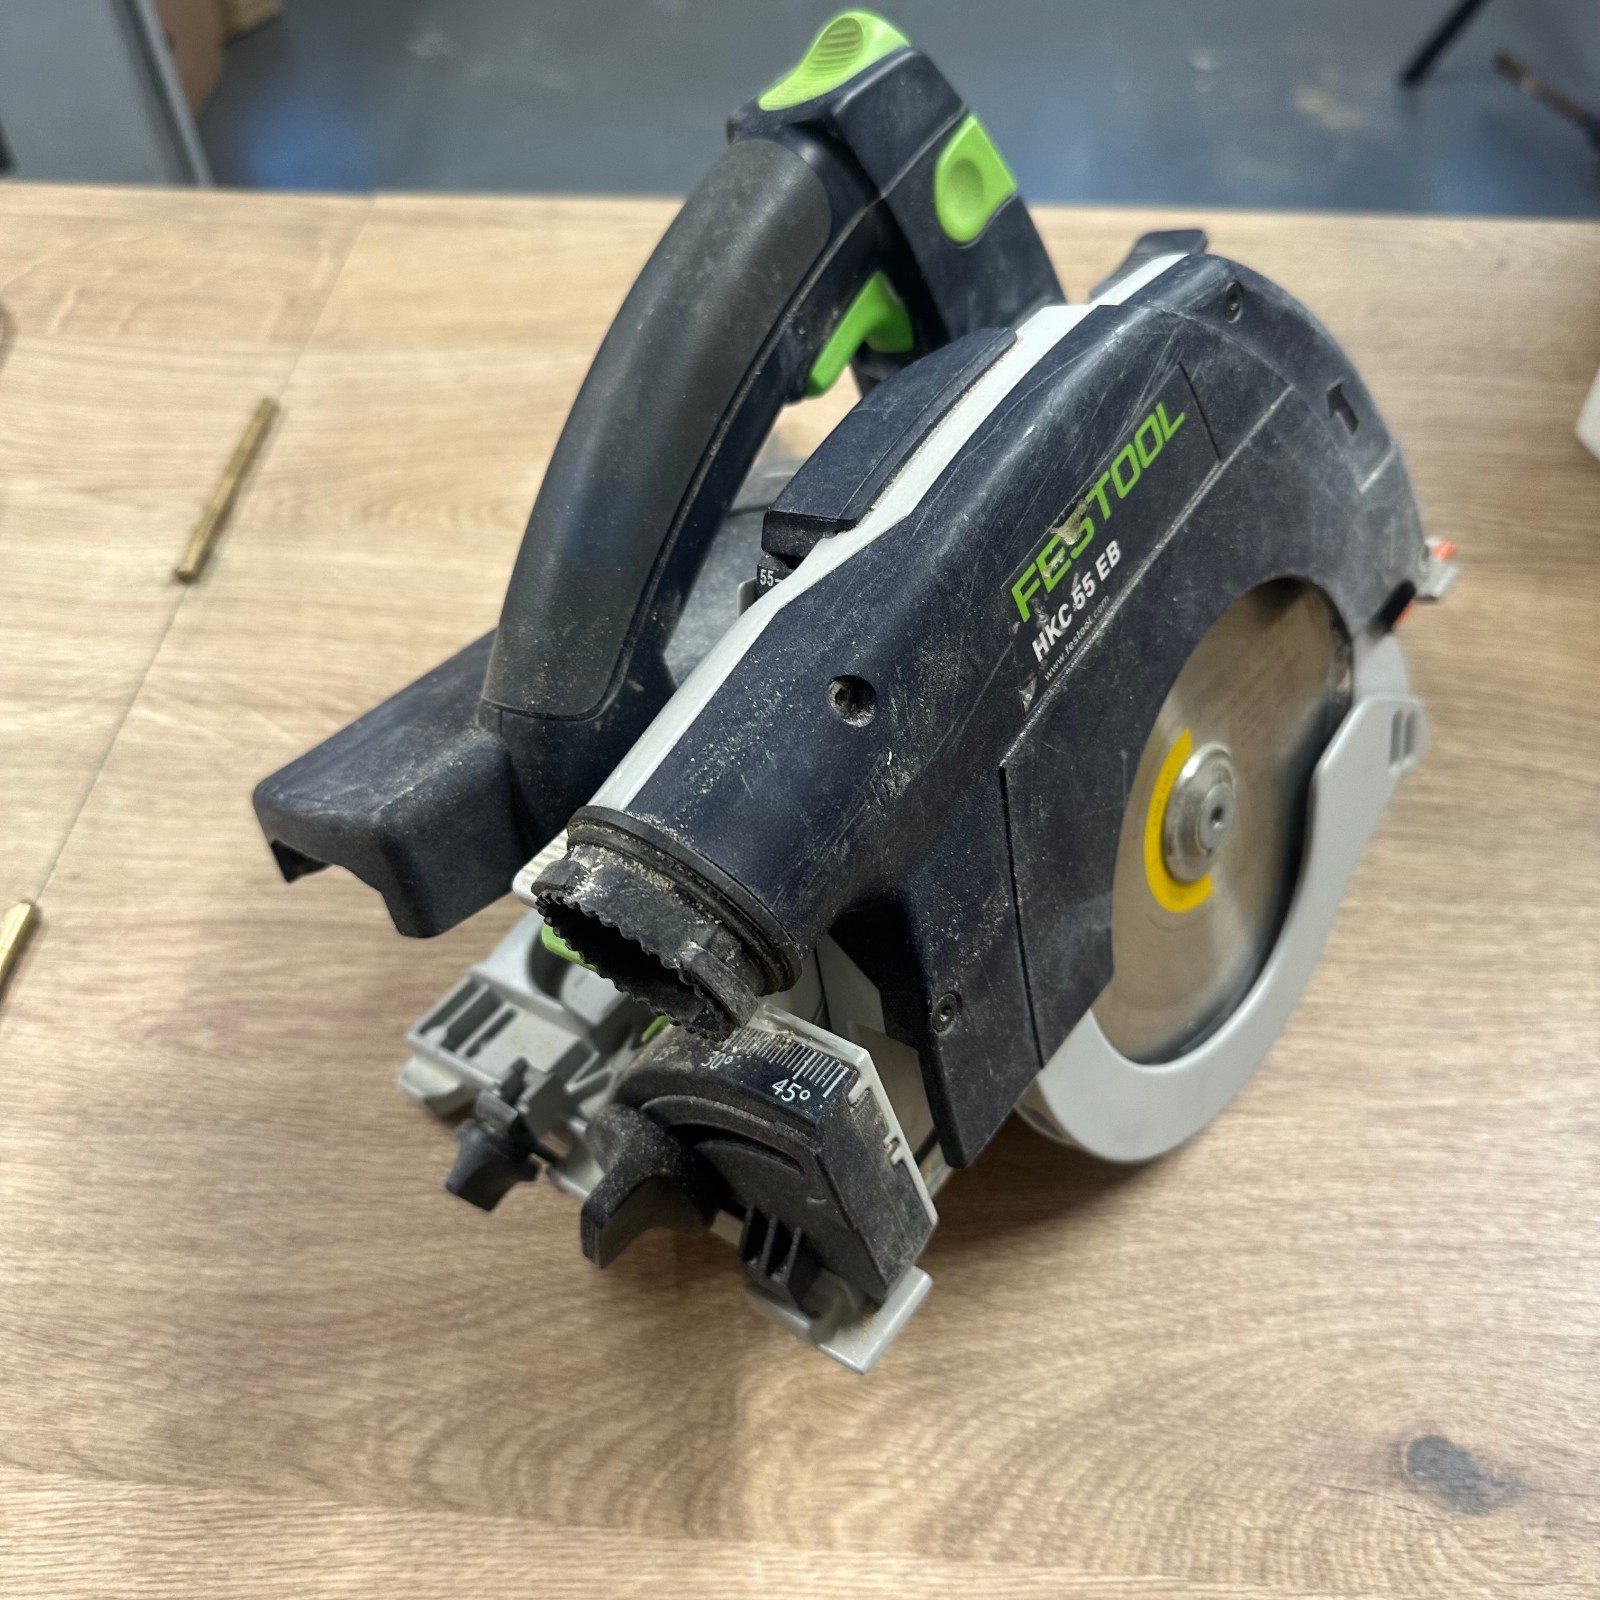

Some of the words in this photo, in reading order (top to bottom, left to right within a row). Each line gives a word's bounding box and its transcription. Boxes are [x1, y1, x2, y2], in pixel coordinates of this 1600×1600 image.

[1011, 402, 1187, 623] FESTOOL
[1032, 603, 1073, 663] HKC
[1071, 571, 1097, 611] 55
[1095, 540, 1122, 582] EB
[1044, 595, 1110, 681] www.festool.com
[772, 1078, 811, 1102] 45°
